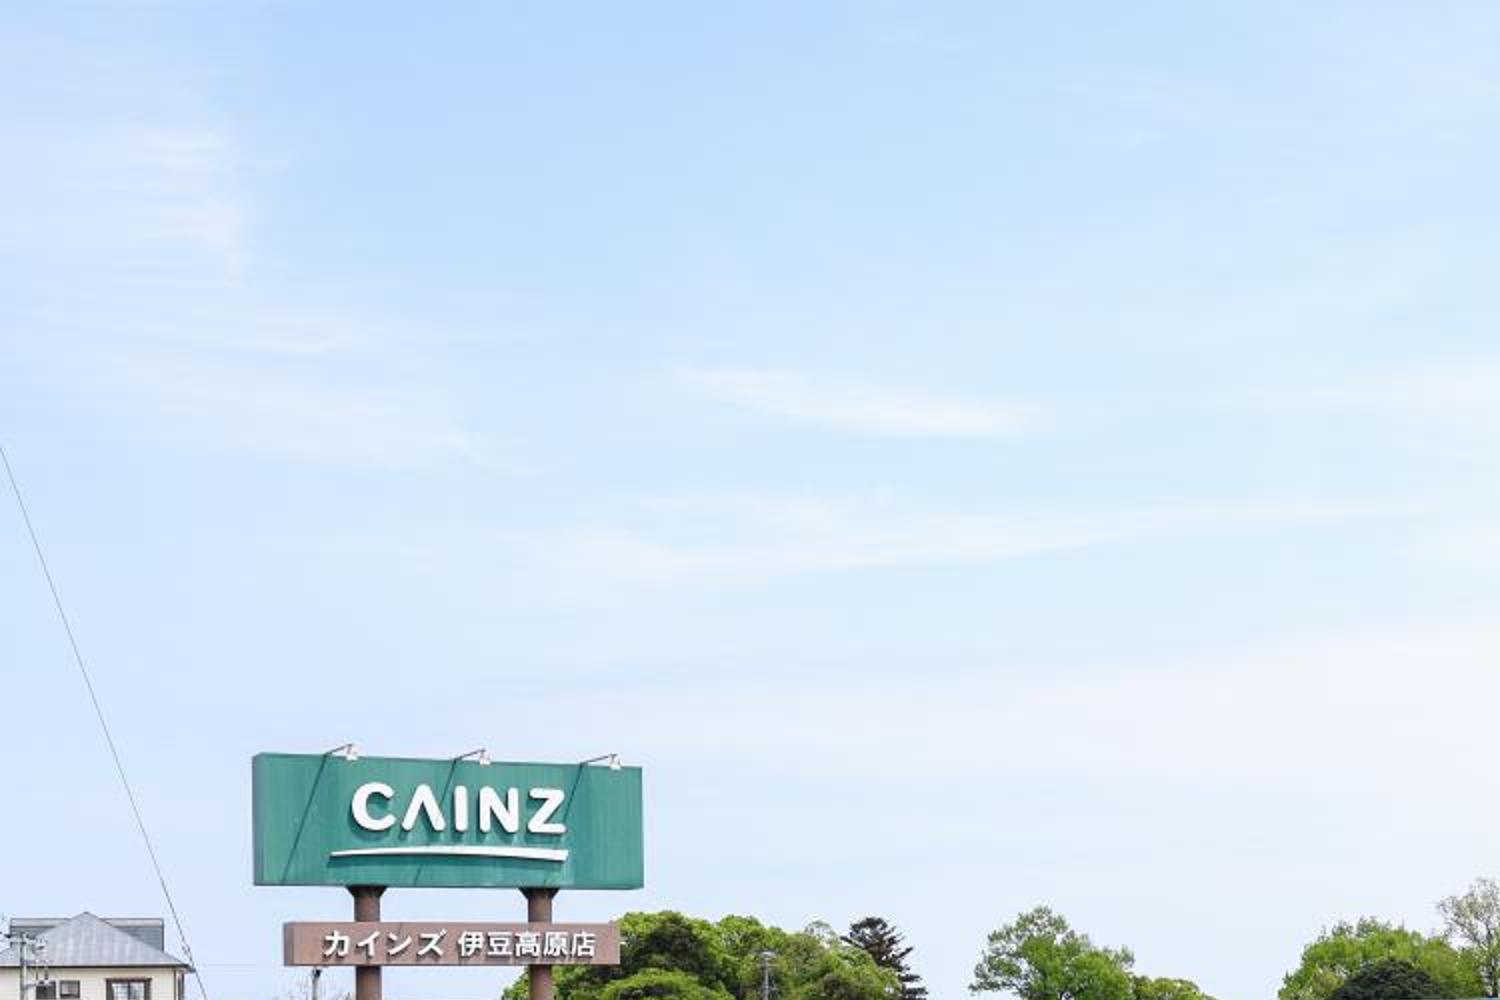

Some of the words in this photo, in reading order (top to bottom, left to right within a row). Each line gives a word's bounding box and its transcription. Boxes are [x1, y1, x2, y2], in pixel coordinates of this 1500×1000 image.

[351, 782, 567, 834] CAINZ
[323, 930, 447, 957] カインズ
[458, 931, 596, 957] 伊豆高原店
